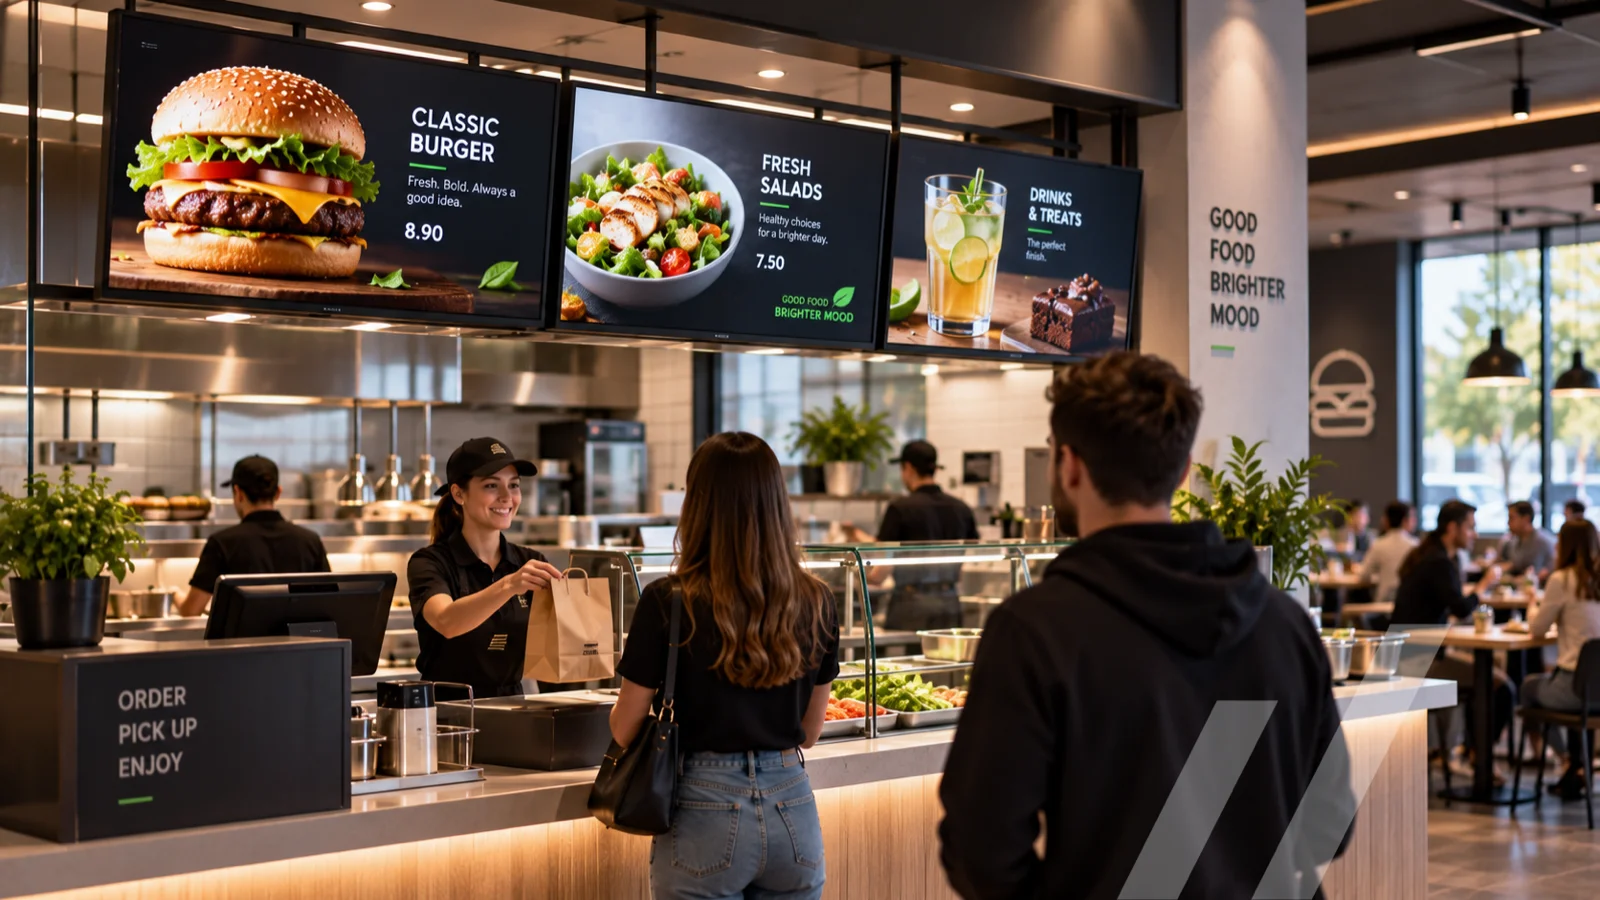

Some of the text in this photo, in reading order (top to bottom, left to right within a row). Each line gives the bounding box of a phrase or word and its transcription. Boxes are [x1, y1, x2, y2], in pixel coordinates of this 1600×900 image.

[412, 106, 500, 137] CLASSIC
[410, 132, 495, 163] BURGER
[762, 154, 811, 177] FRESH
[408, 175, 516, 198] Fresh. Bold. Always a
[760, 176, 823, 200] SALADS
[1030, 187, 1072, 207] DRINKS
[407, 193, 463, 208] good idea.
[759, 213, 821, 229] Healthy choices
[1028, 206, 1082, 227] & TREATS
[1210, 206, 1257, 233] GOOD
[405, 222, 443, 242] 8.90
[758, 227, 770, 237] for
[778, 228, 810, 243] brighter
[812, 233, 828, 245] day.
[1027, 237, 1066, 251] The perfect
[1210, 238, 1255, 264] FOOD
[756, 253, 785, 270] 7.50
[1026, 250, 1047, 262] finish.
[1210, 271, 1285, 299] BRIGHTER
[782, 294, 829, 307] GOOD FOOD
[775, 306, 854, 323] BRIGHTER MOOD
[1211, 303, 1260, 327] MOOD
[118, 686, 187, 711] ORDER
[119, 717, 198, 745] PICK UP
[118, 751, 184, 778] ENJOY
